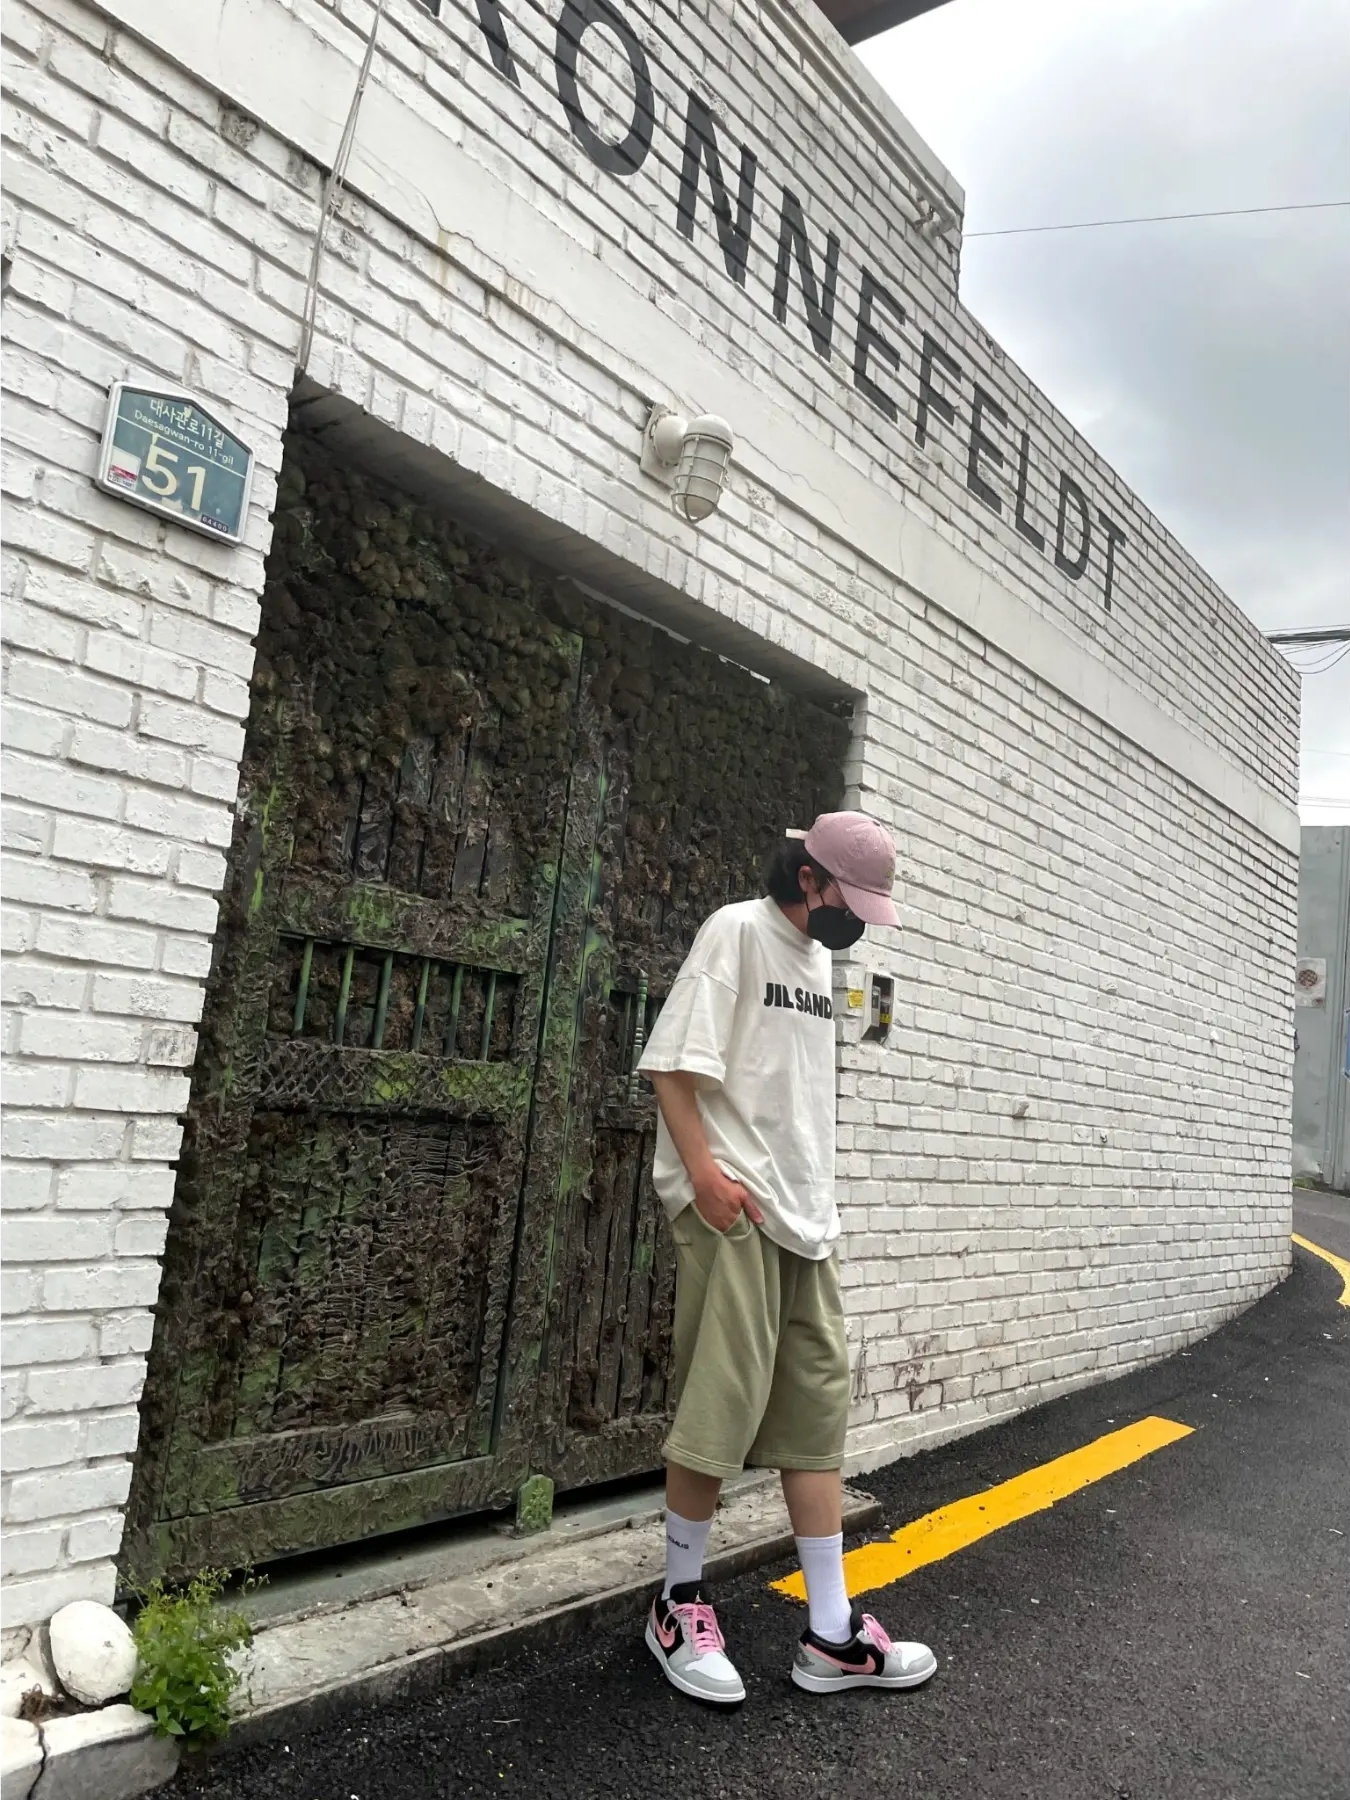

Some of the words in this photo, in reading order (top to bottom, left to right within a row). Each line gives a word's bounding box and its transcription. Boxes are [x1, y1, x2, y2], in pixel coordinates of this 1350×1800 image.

[134, 409, 205, 451] Daesagwan-ro
[208, 445, 234, 465] 11-gil
[150, 399, 225, 450] 대사관로11길
[142, 444, 206, 511] 51
[763, 982, 795, 1009] JIL
